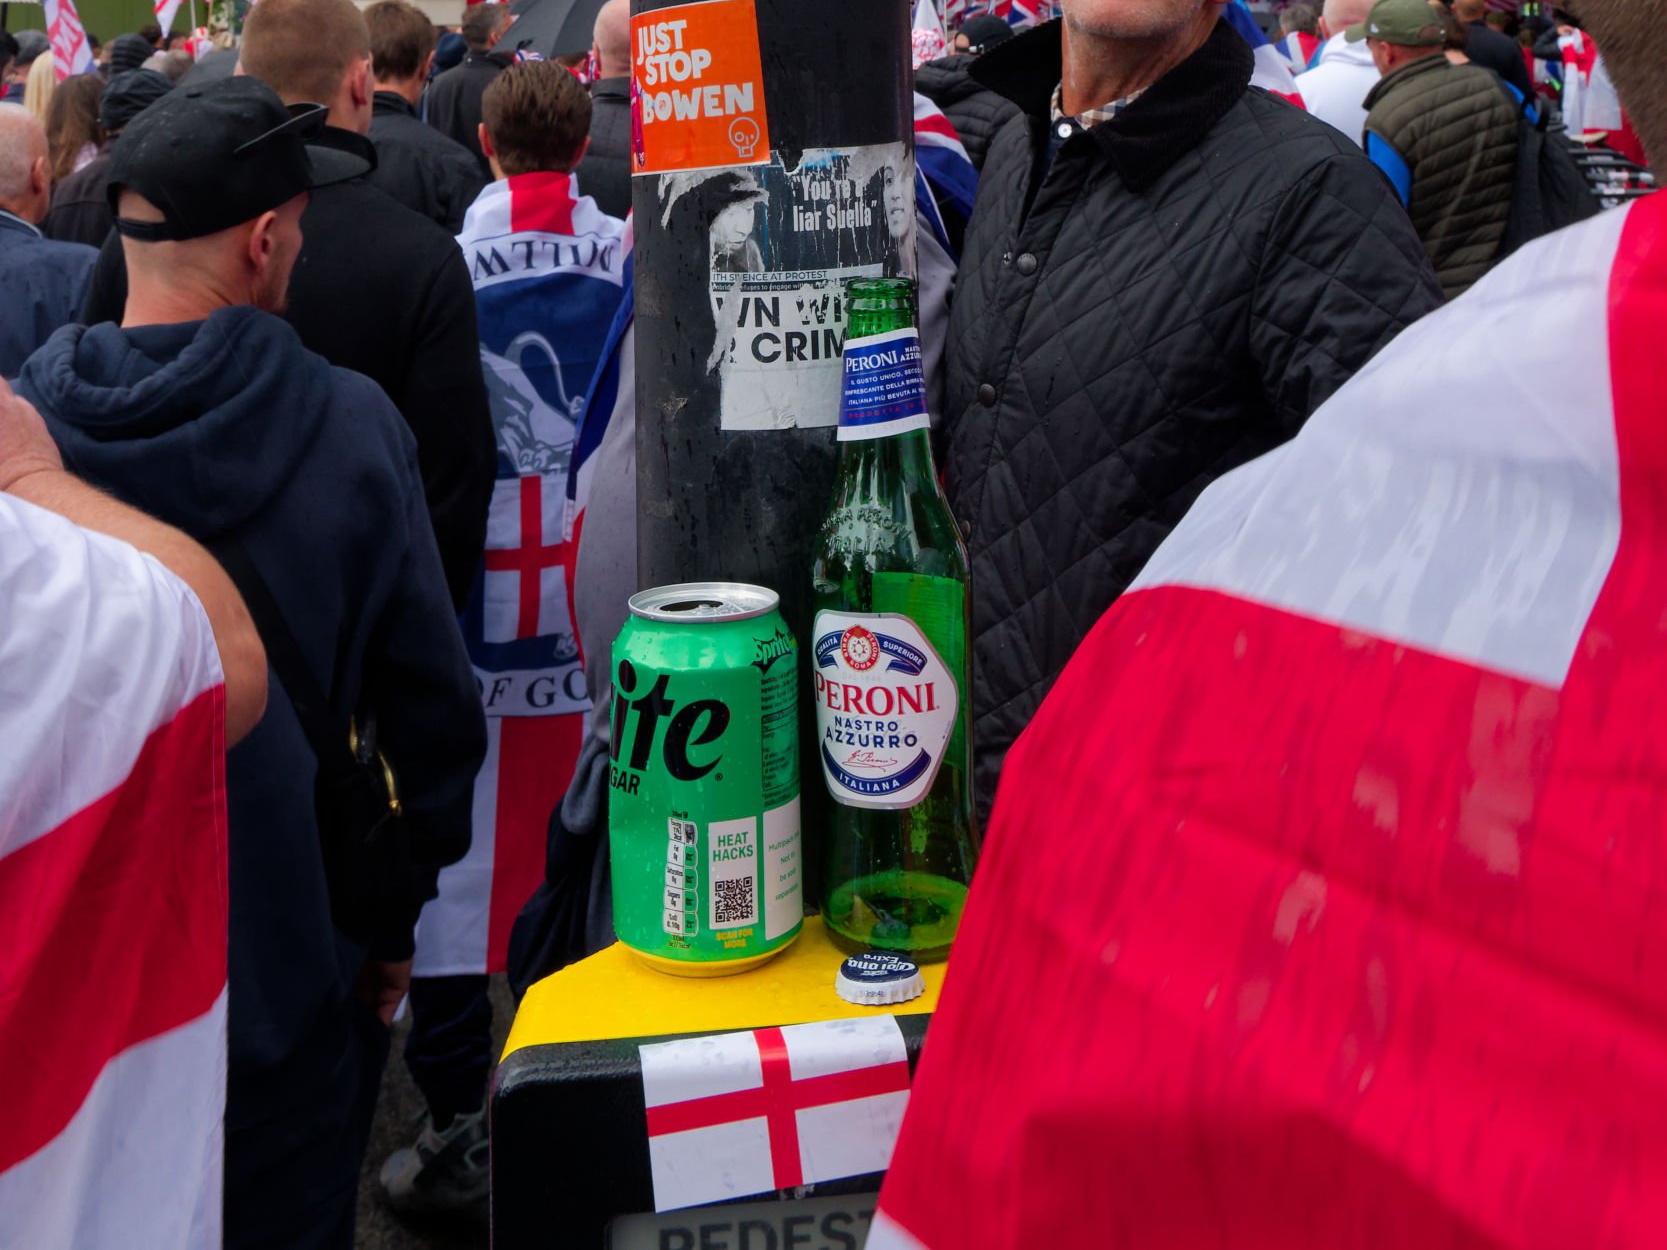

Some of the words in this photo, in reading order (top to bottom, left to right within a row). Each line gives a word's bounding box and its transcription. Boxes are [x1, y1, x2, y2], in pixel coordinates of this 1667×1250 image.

[637, 19, 688, 67] JUST
[644, 48, 712, 86] STOP
[642, 81, 755, 125] BOWEN
[793, 205, 822, 232] liar
[713, 273, 727, 282] ITH
[770, 272, 783, 282] AT
[785, 270, 829, 281] PROTEST
[751, 327, 848, 364] CRIM
[845, 350, 898, 373] PERONI
[856, 376, 878, 385] GUSTO
[885, 382, 905, 390] DELLA
[848, 397, 873, 406] ITALIANA
[887, 389, 911, 400] BEVUTA
[866, 633, 879, 663] PERONI
[882, 640, 924, 667] SUPERIORE
[850, 660, 872, 670] ROMA
[815, 670, 935, 716] PERONI
[610, 659, 731, 781] ite
[834, 715, 899, 732] NASTRO
[826, 725, 918, 749] AZZURRO
[839, 772, 901, 793] ITALIANA
[717, 831, 749, 848] HEAT
[712, 844, 754, 863] HACKS
[863, 953, 900, 964] Extra
